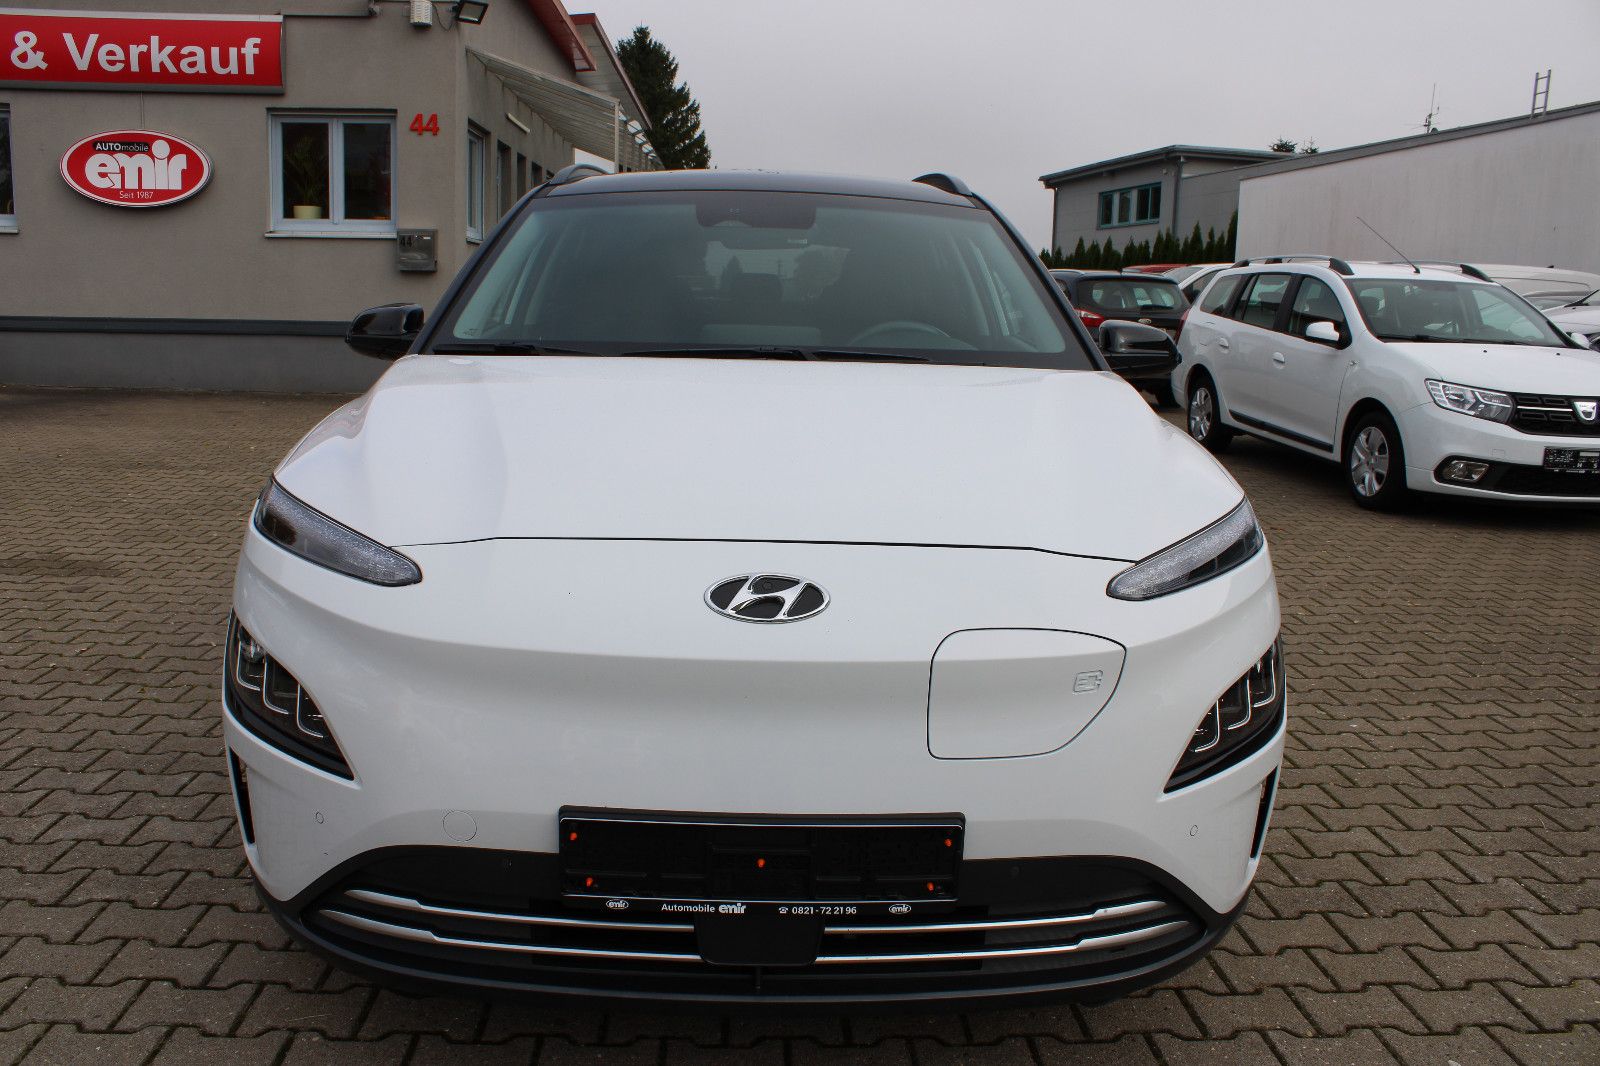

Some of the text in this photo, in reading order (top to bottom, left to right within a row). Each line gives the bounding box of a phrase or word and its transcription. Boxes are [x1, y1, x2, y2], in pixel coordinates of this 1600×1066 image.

[11, 31, 261, 75] & Verkauf
[409, 113, 440, 136] 44
[95, 142, 149, 151] AUTOmobile
[85, 139, 188, 190] emir
[119, 190, 154, 199] Seit 1987
[608, 899, 626, 908] emir
[661, 902, 746, 914] Automobile emir
